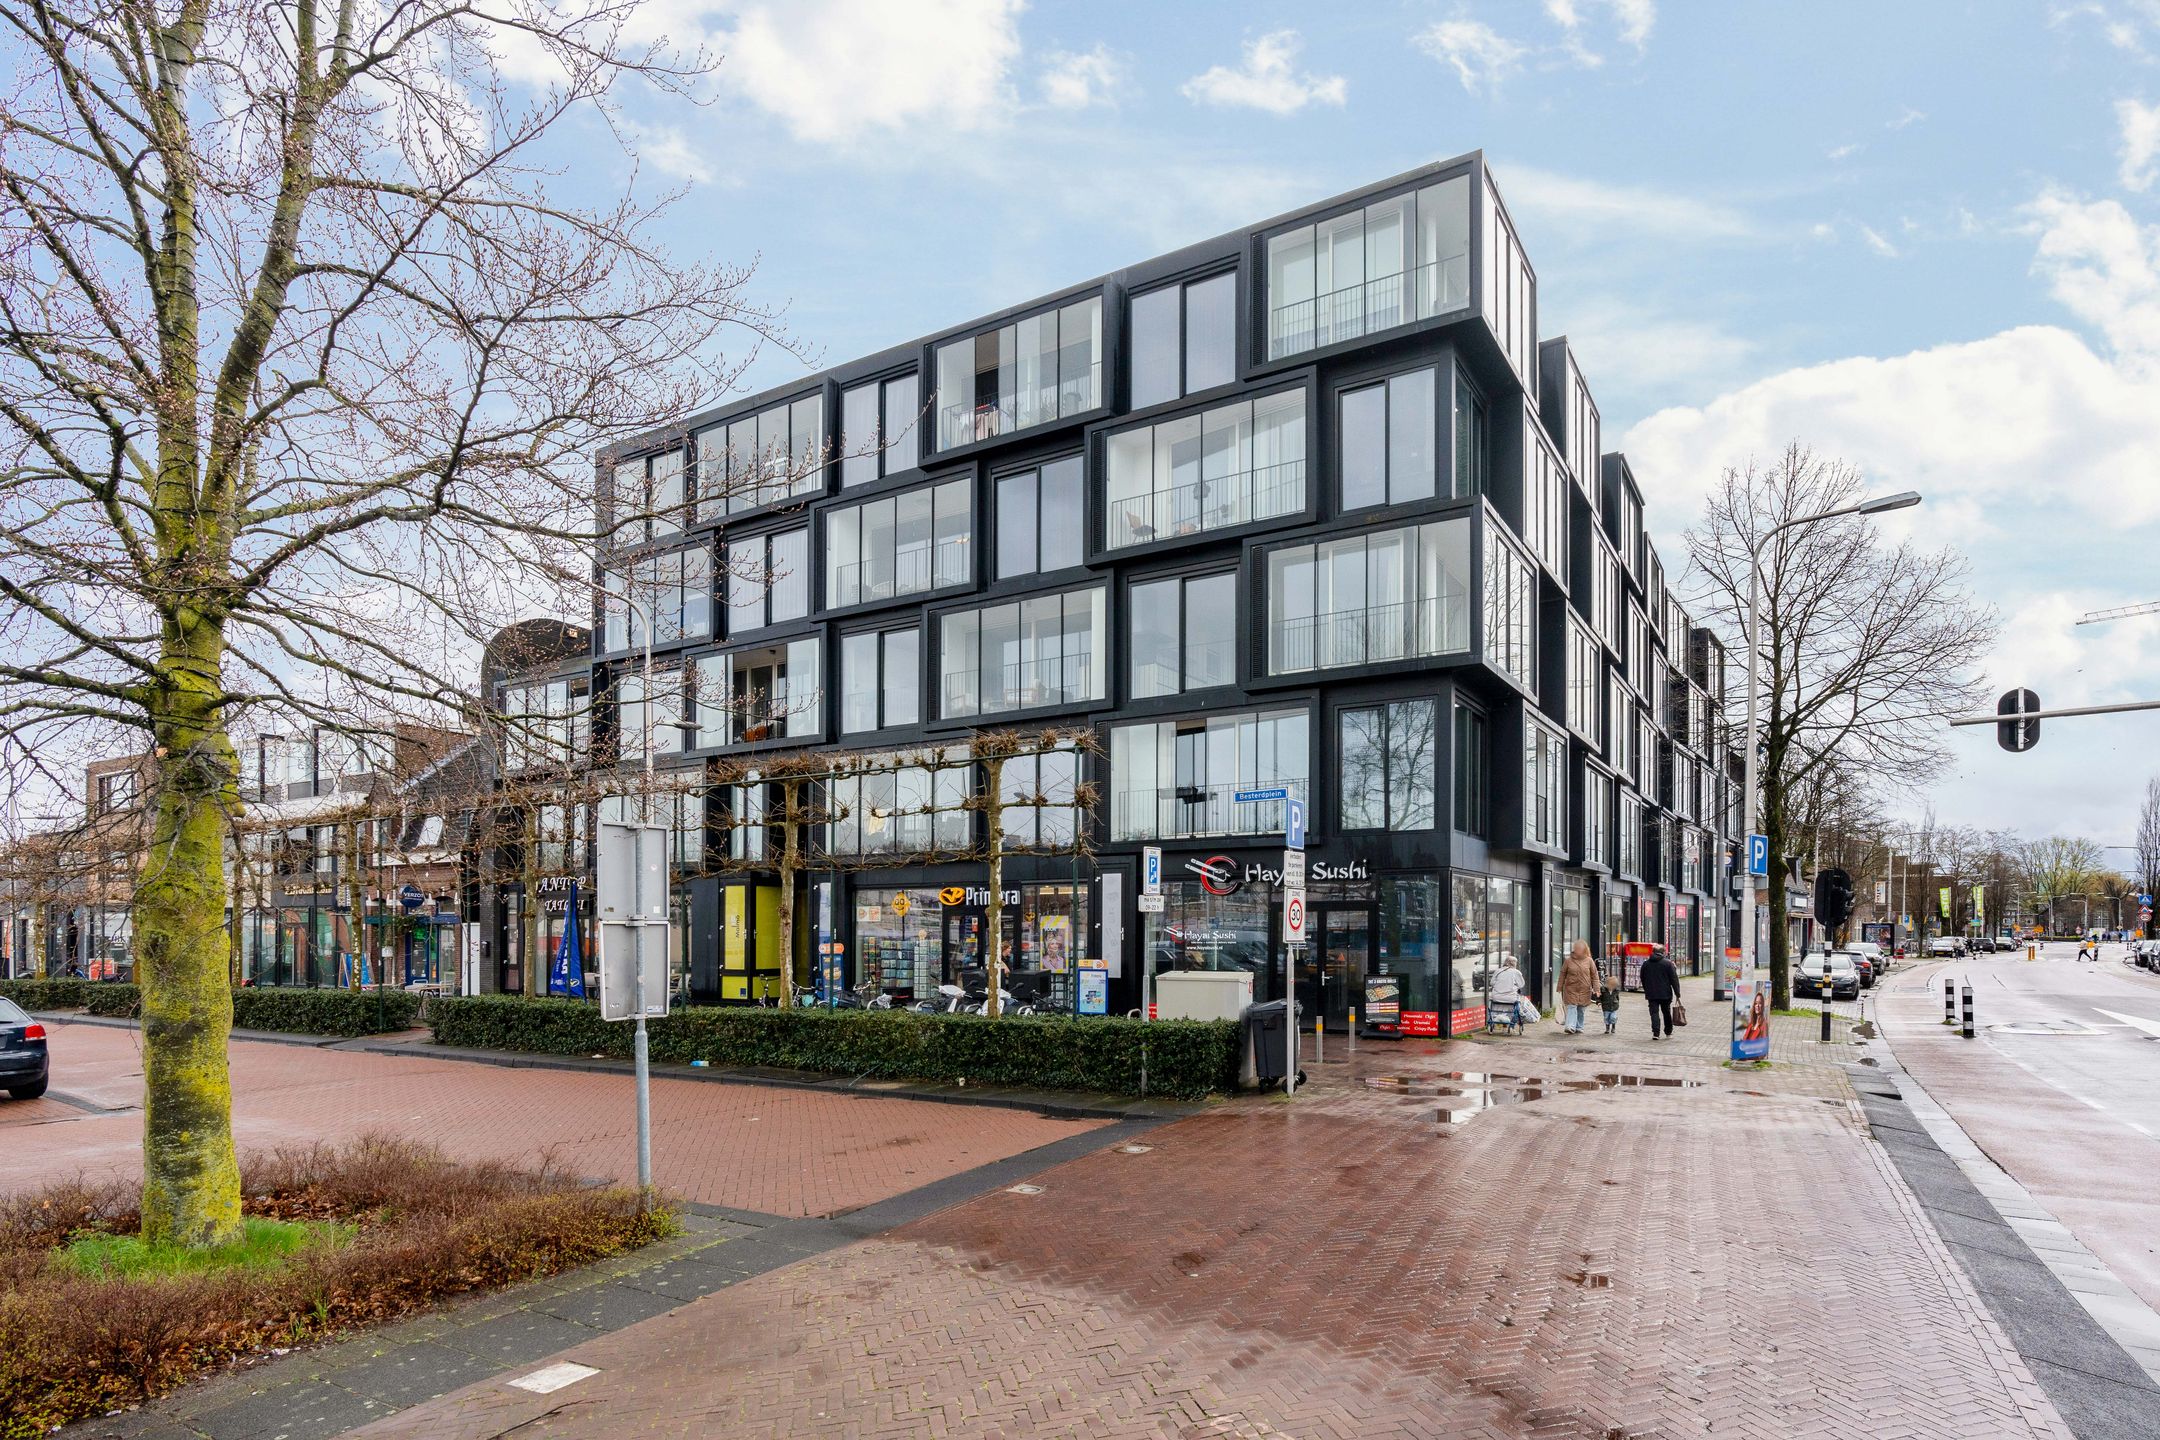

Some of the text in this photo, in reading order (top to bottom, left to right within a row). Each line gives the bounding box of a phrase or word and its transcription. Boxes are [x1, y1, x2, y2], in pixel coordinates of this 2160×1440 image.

[1239, 790, 1282, 800] Besterdplein
[1291, 805, 1301, 842] P
[1754, 840, 1764, 869] P
[1312, 859, 1368, 880] Sushi
[1291, 908, 1300, 921] 30
[1184, 930, 1237, 942] Hayai Sushi
